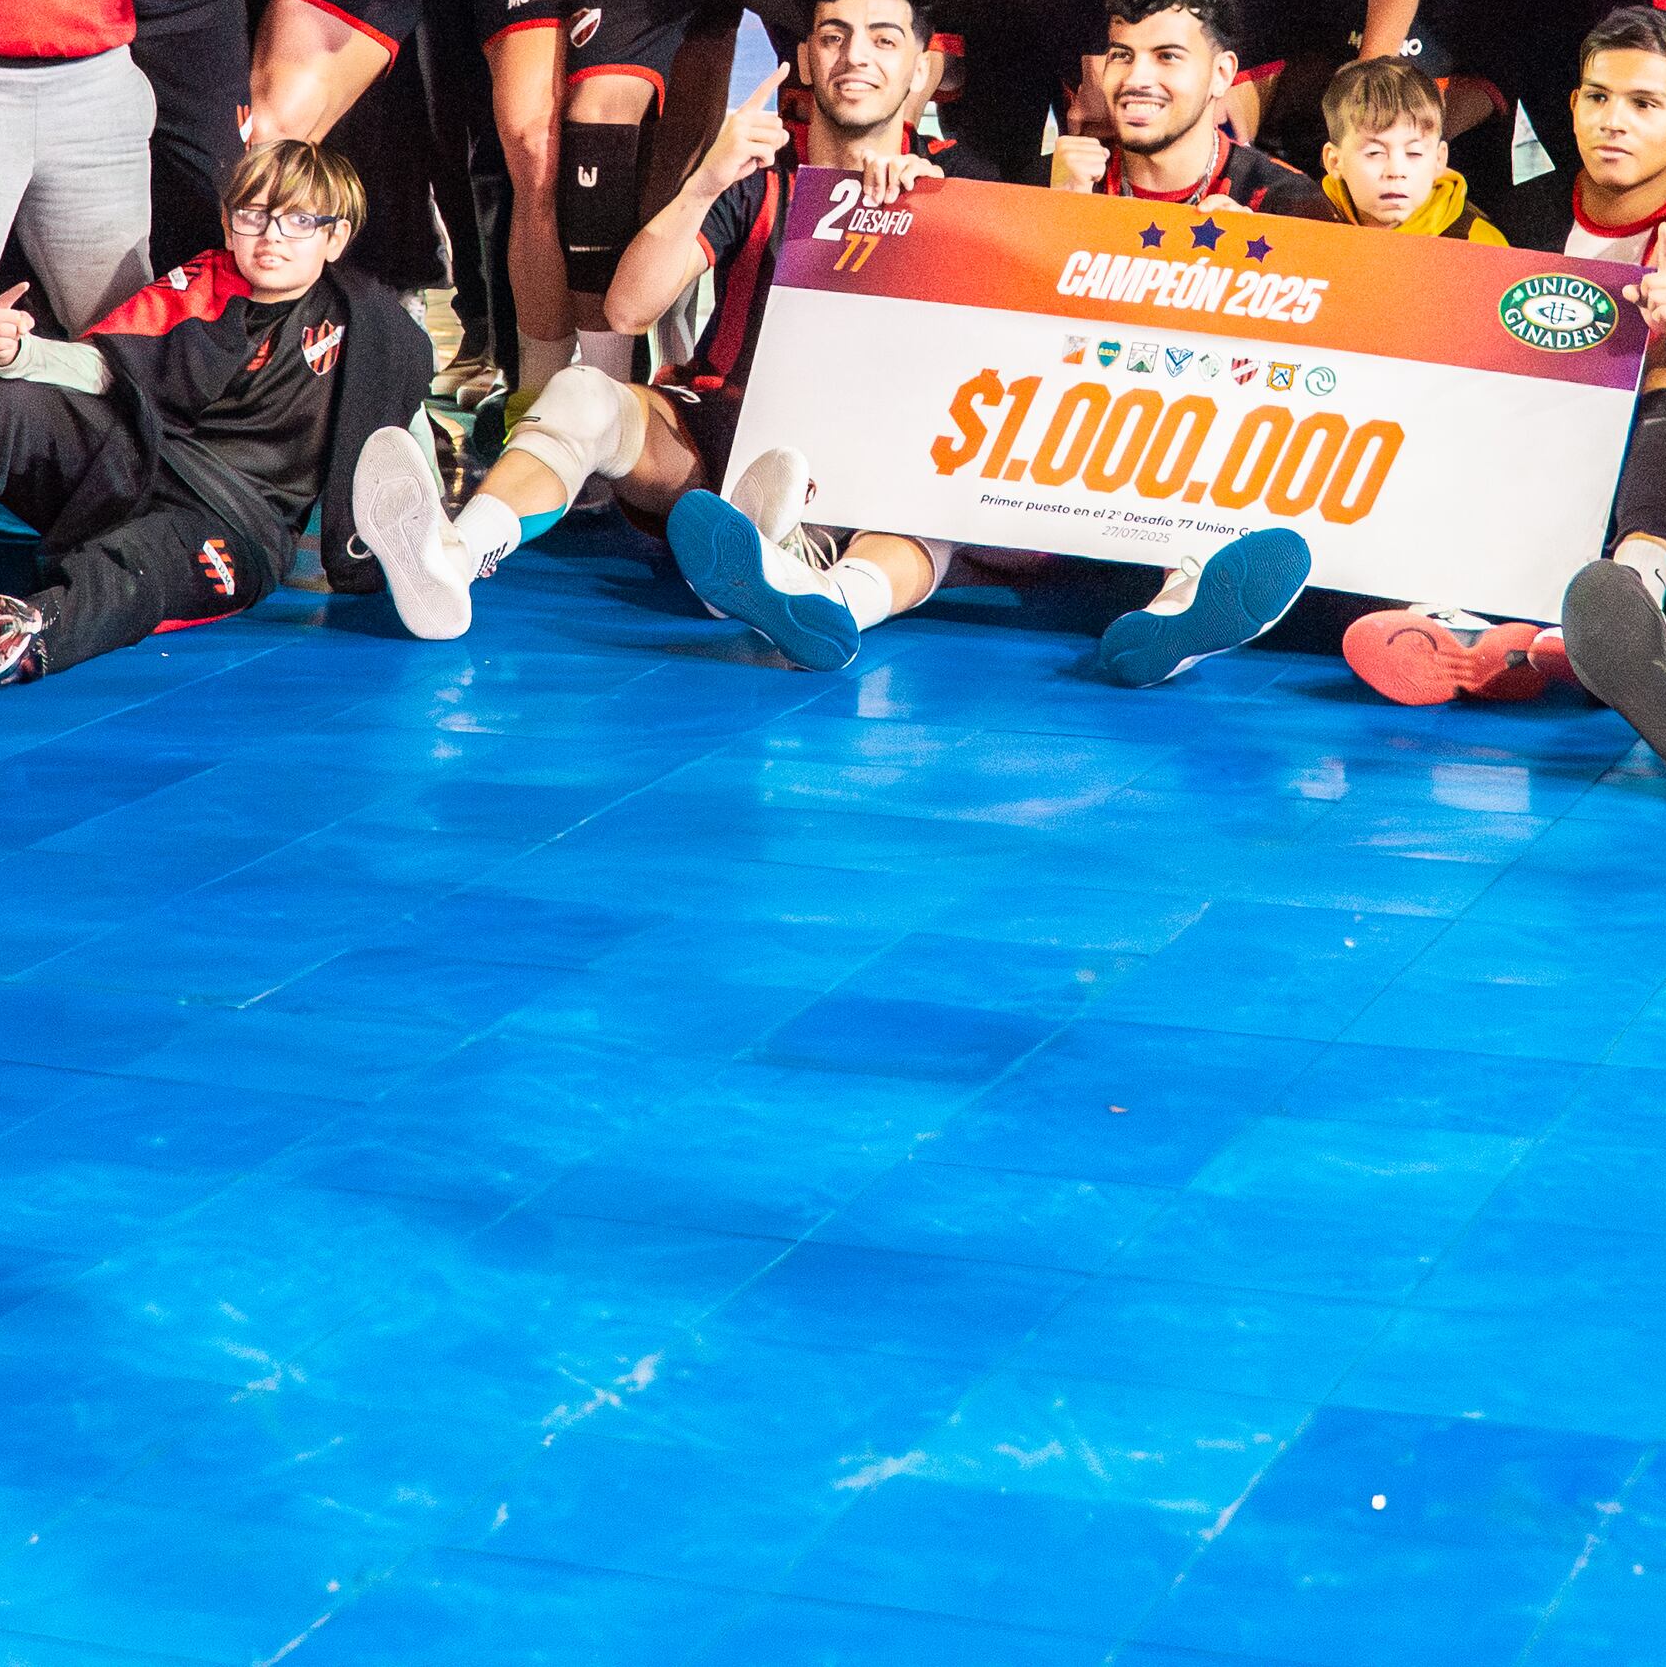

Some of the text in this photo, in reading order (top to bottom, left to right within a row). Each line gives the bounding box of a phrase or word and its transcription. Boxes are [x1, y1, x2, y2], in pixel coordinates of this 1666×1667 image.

[848, 208, 913, 236] DESAFÍO
[833, 233, 881, 272] 77
[1057, 251, 1329, 324] CAMPEÓN 2025
[1525, 277, 1601, 306] UNION
[1504, 308, 1612, 349] GANADERA
[929, 368, 1406, 525] $1.000.000
[980, 494, 1023, 508] Primer
[1025, 501, 1070, 514] puesto
[1073, 507, 1090, 517] en
[1093, 508, 1106, 518] el
[1177, 519, 1194, 528] 77
[1101, 524, 1171, 544] 27/07/2025
